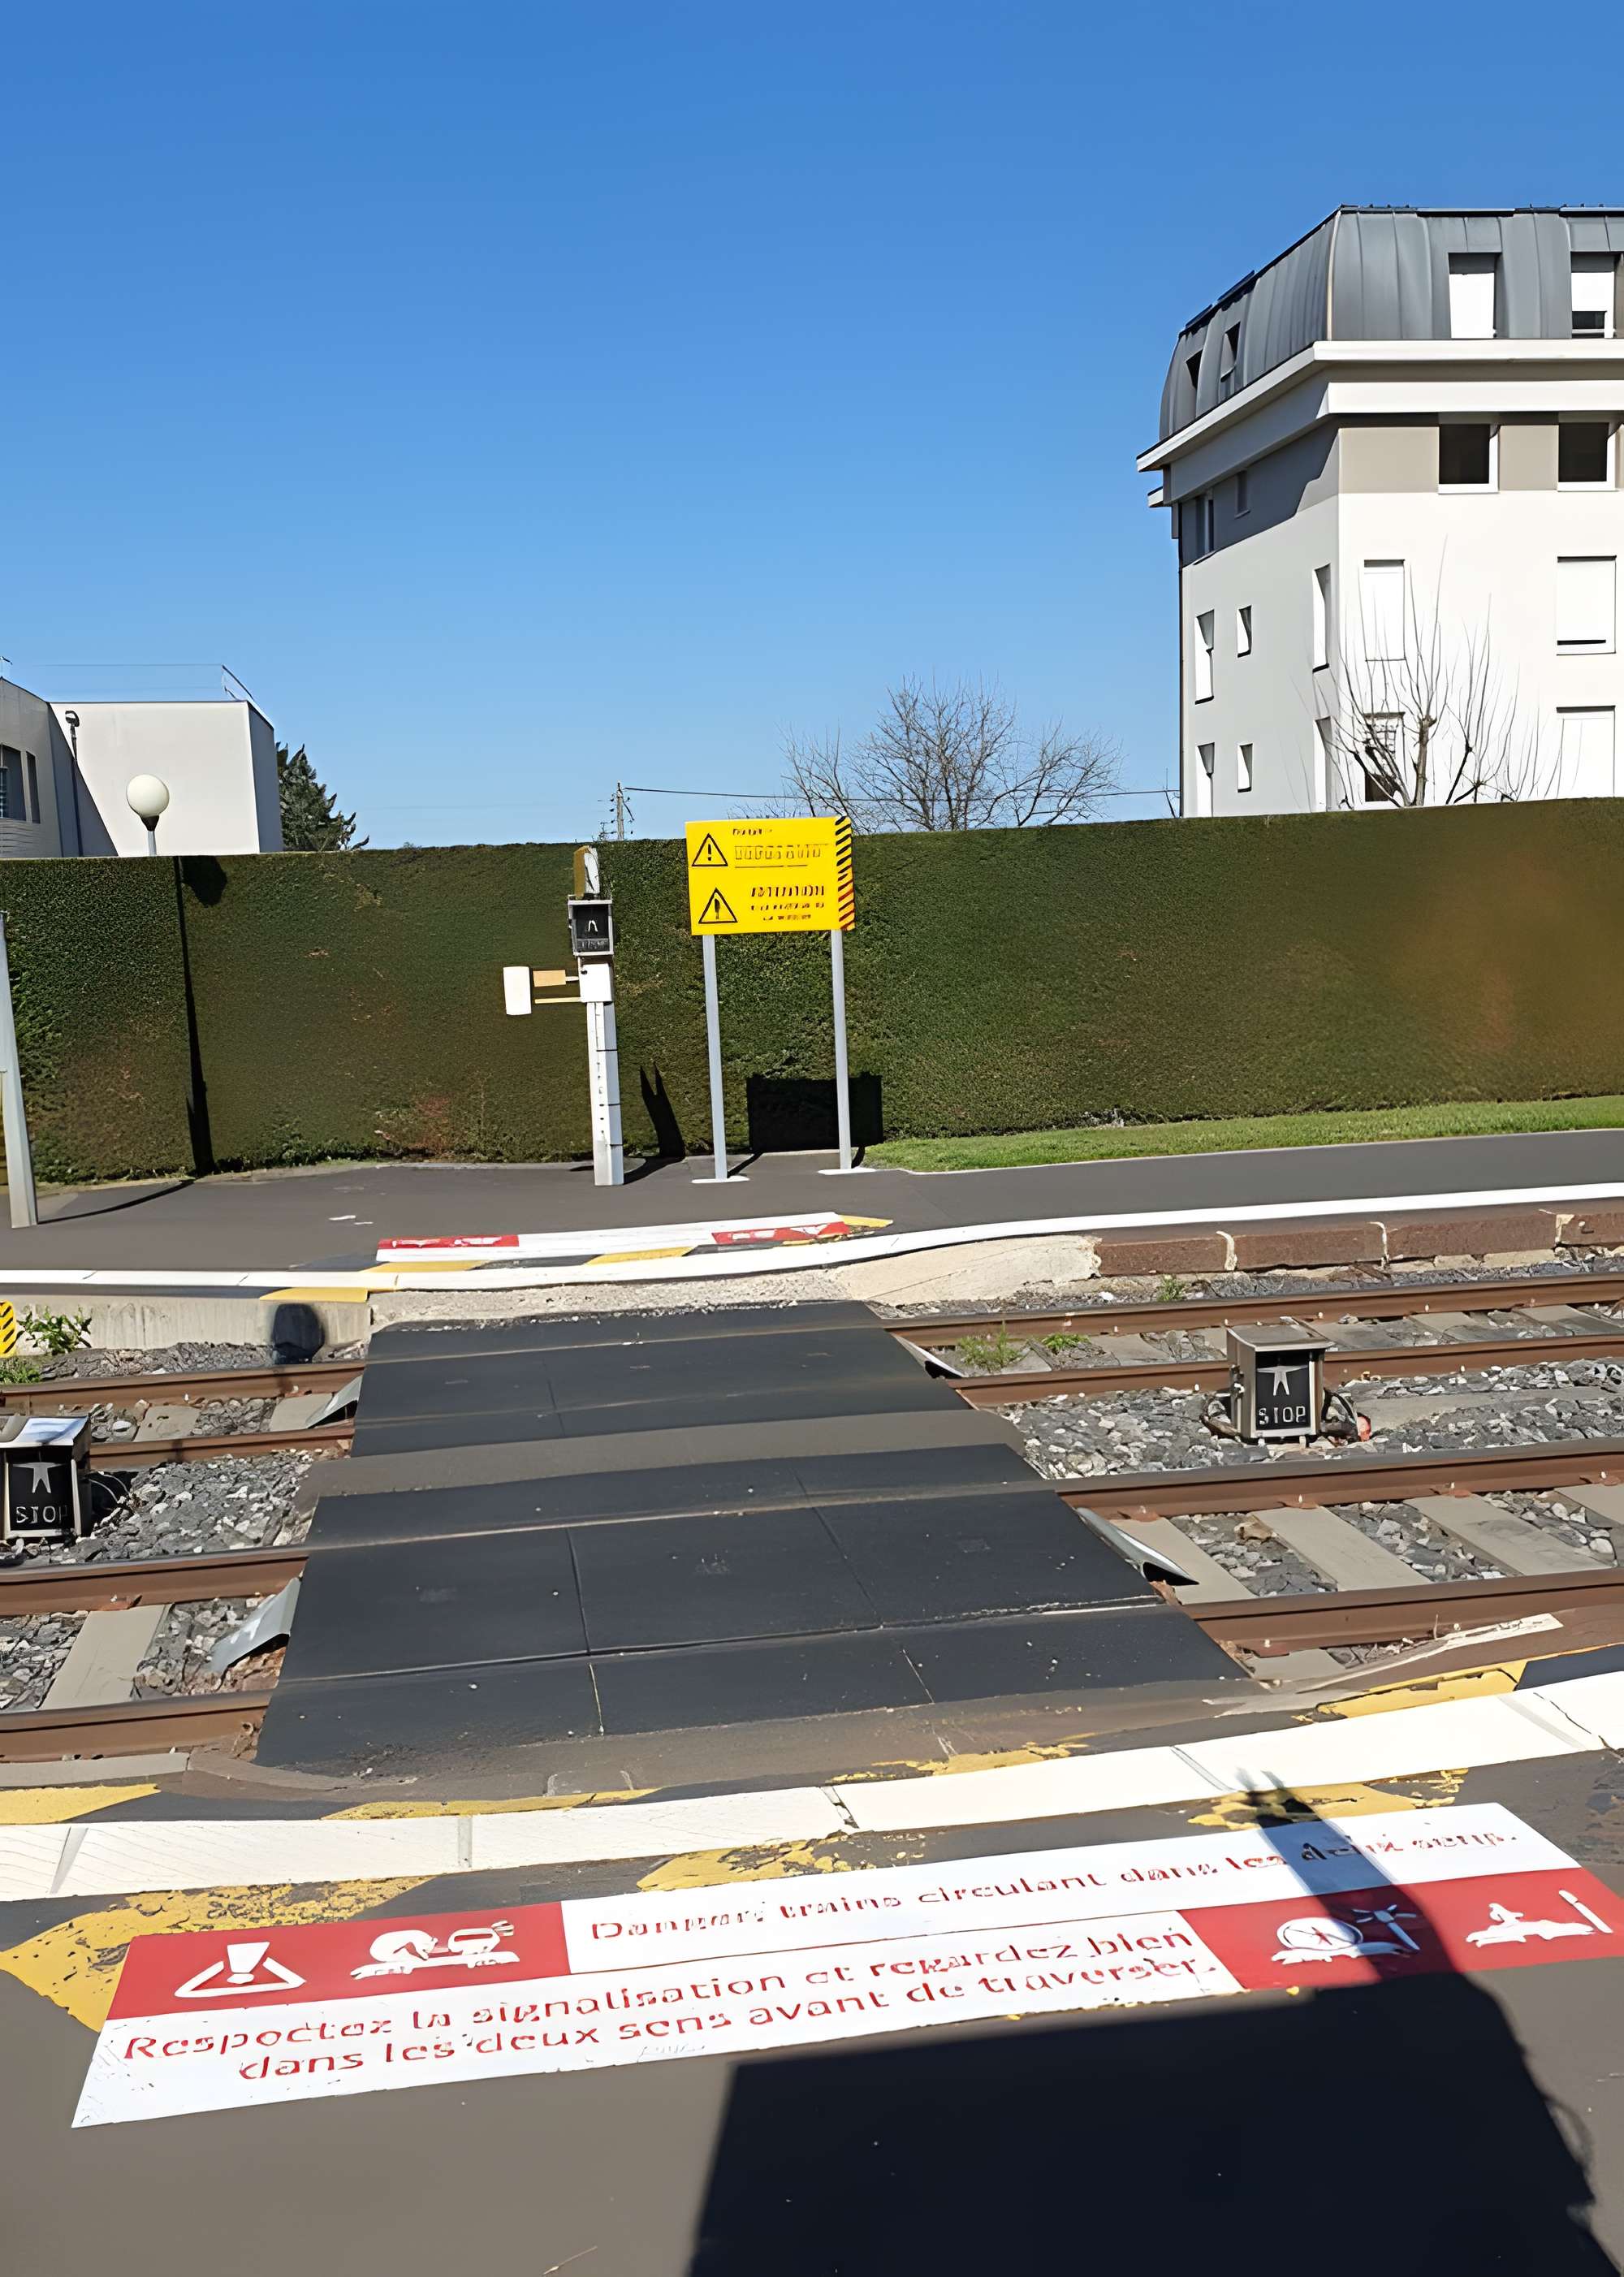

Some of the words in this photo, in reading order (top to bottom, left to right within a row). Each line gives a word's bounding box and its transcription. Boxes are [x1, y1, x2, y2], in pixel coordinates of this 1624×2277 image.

[1258, 1406, 1306, 1425] STOP
[15, 1504, 69, 1524] STOP
[238, 2053, 364, 2080] dans
[474, 2025, 601, 2054] deux
[749, 1991, 890, 2026] avant
